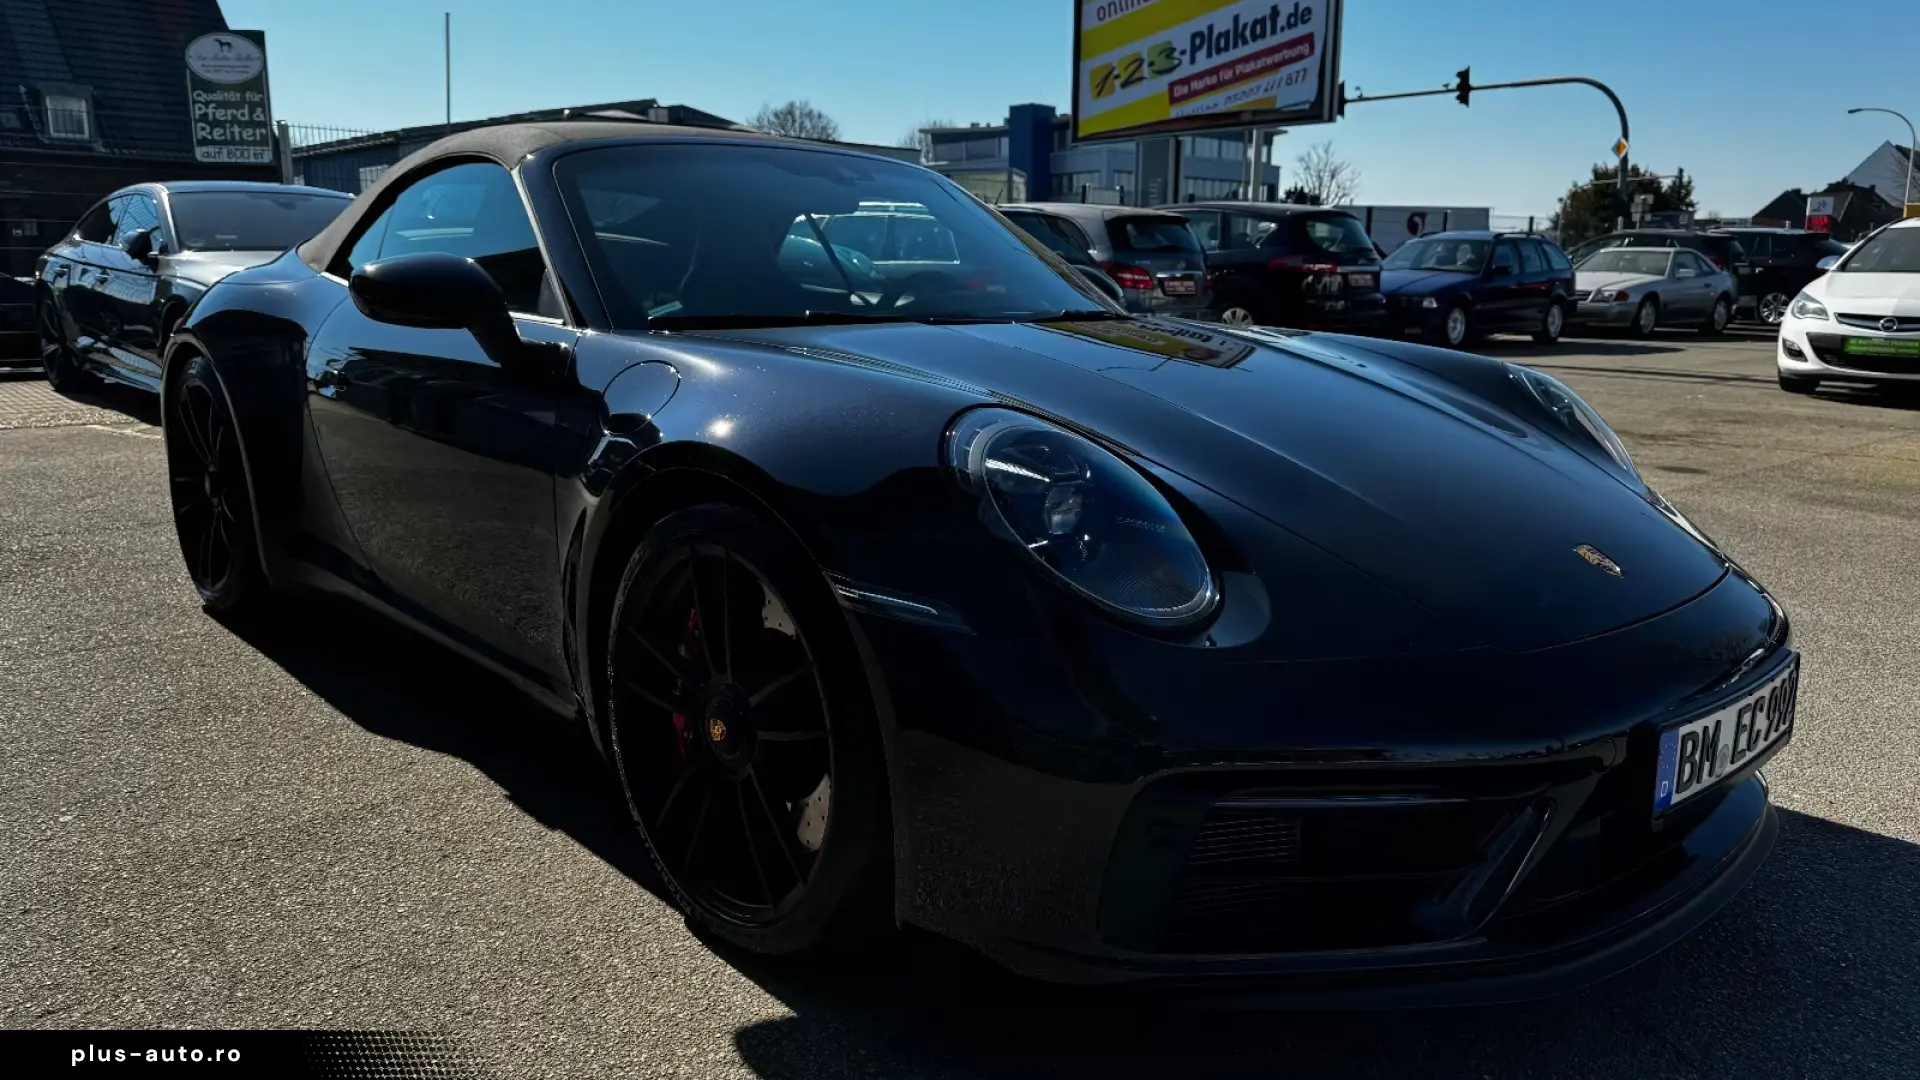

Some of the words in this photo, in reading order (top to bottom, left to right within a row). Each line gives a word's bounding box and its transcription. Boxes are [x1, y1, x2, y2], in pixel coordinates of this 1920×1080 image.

[1097, 0, 1153, 22] onlin
[1173, 81, 1189, 97] Die
[1190, 71, 1218, 91] Marke
[1218, 66, 1234, 82] für
[1234, 43, 1310, 77] Plakatwerbung
[192, 90, 241, 103] Qualität
[245, 91, 264, 102] für
[194, 103, 250, 121] Pferd
[252, 108, 265, 121] &
[196, 122, 267, 141] Reiter
[1675, 719, 1722, 794] BM
[1660, 780, 1669, 798] D
